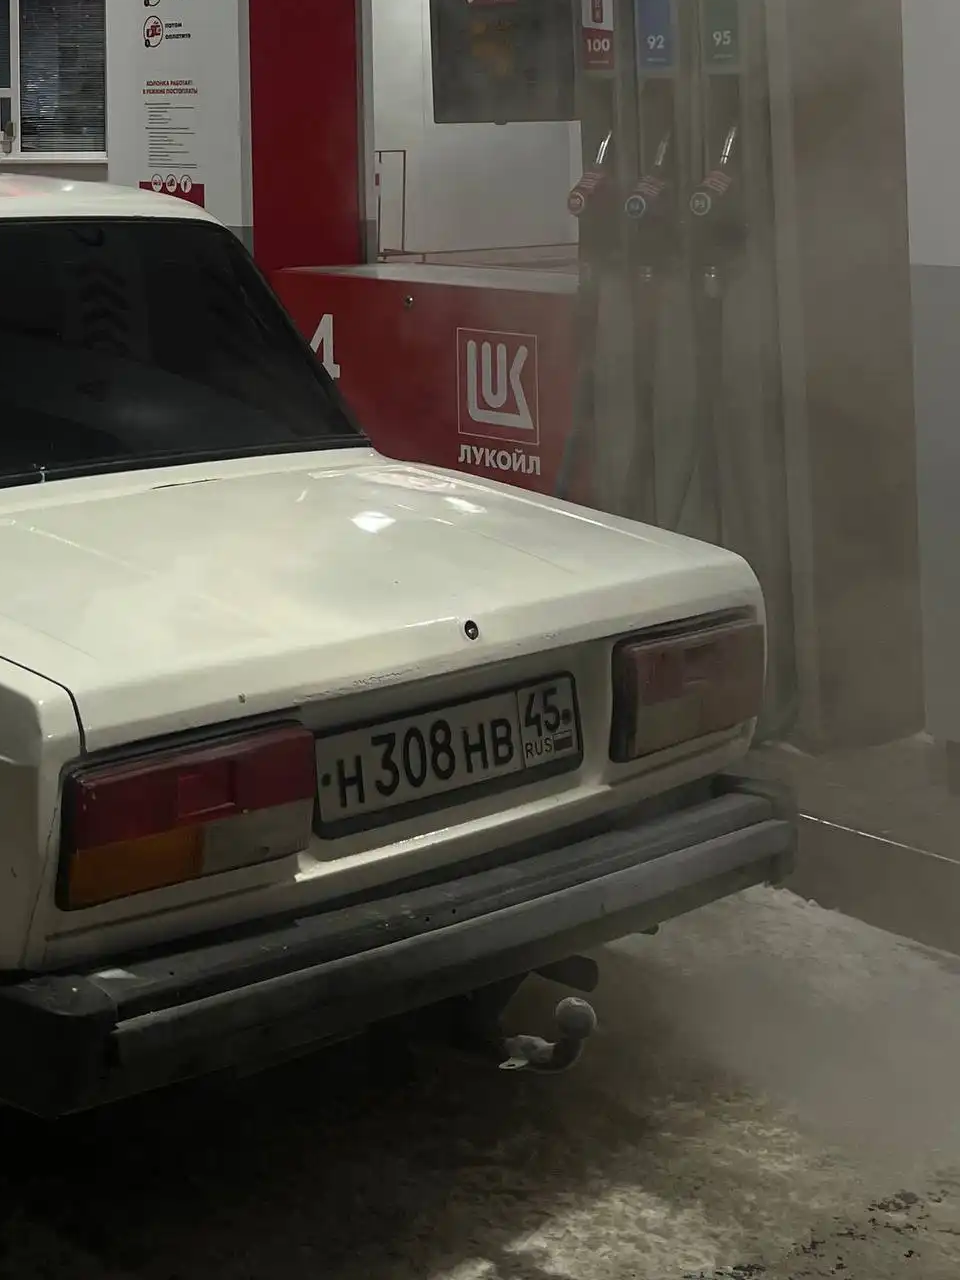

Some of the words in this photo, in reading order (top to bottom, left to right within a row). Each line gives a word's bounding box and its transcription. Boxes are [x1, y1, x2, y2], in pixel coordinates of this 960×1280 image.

[586, 39, 611, 53] 100
[646, 34, 665, 50] 92
[712, 30, 732, 47] 95
[457, 443, 541, 476] ЛУКОЙЛ
[524, 687, 561, 738] 45
[524, 734, 553, 760] RUS
